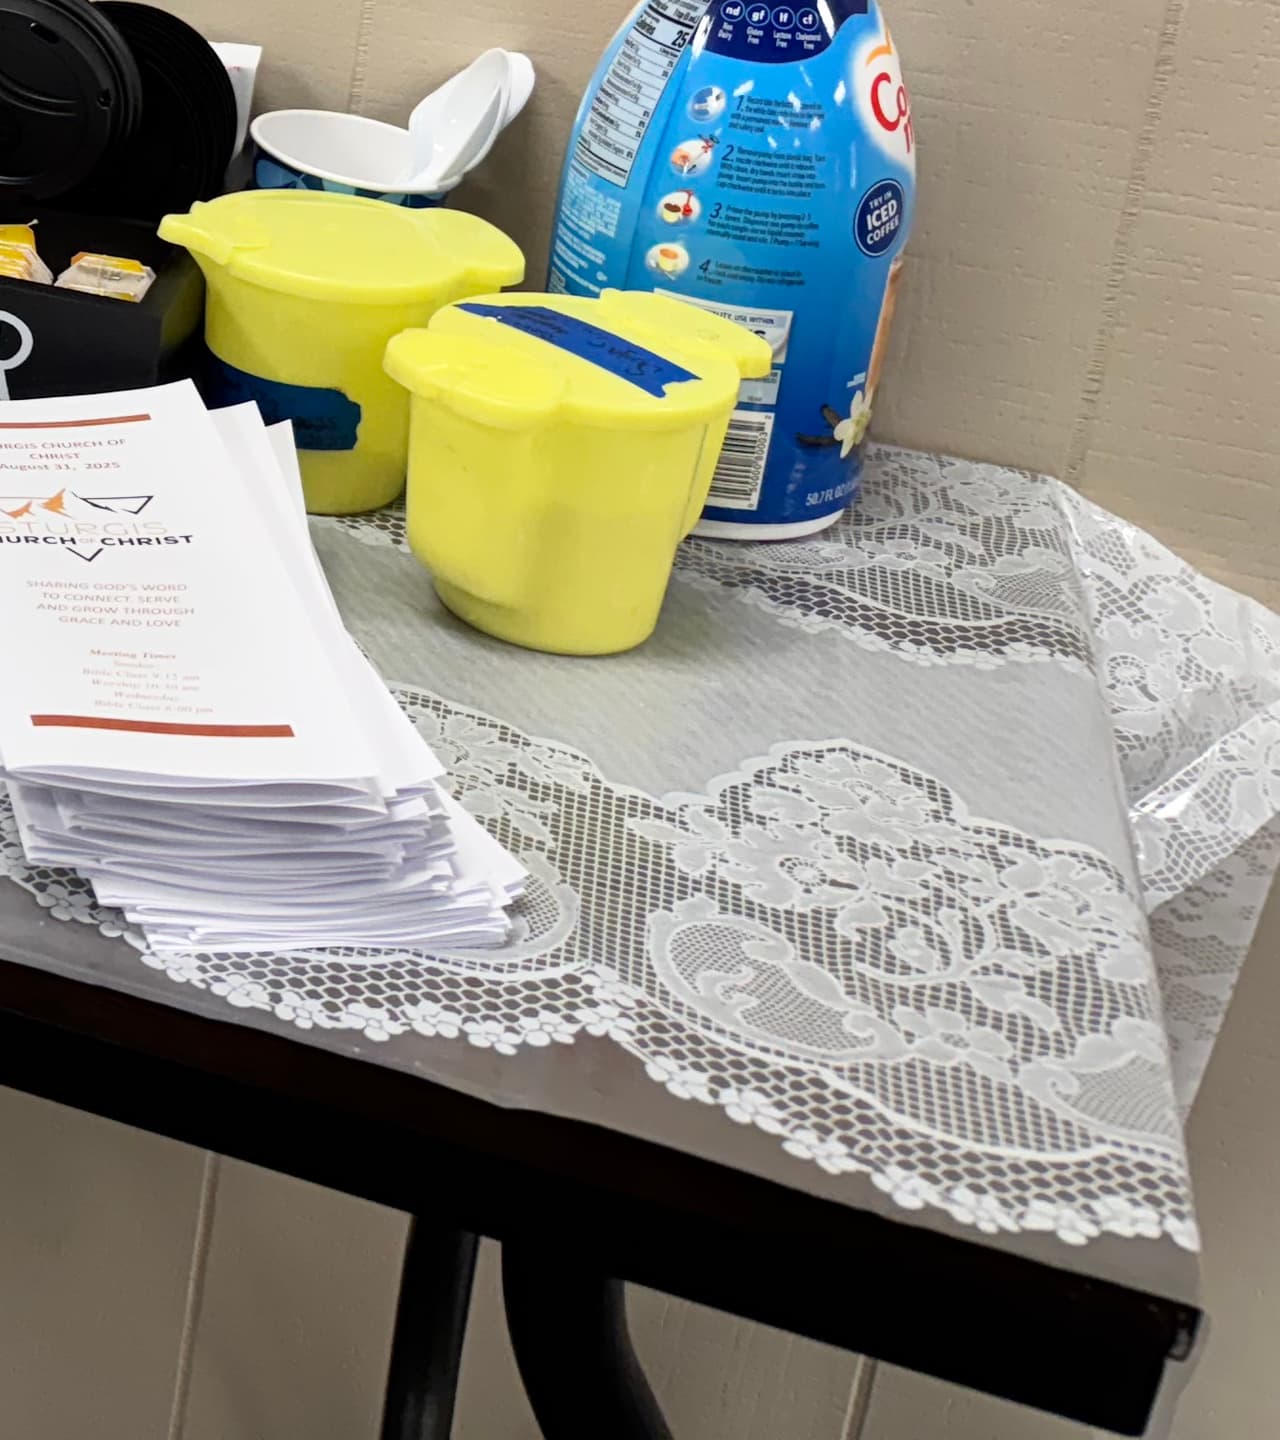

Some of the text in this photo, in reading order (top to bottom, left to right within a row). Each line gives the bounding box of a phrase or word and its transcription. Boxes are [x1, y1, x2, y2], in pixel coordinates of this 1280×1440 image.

[725, 5, 740, 17] nd
[751, 9, 765, 21] gf
[802, 13, 813, 25] cf
[671, 29, 689, 48] 25
[869, 190, 893, 209] TRY IN
[866, 198, 898, 231] ICED
[866, 214, 900, 245] COFFEE
[41, 440, 103, 450] CHURCH
[0, 463, 50, 471] August
[100, 535, 194, 546] CHRIST
